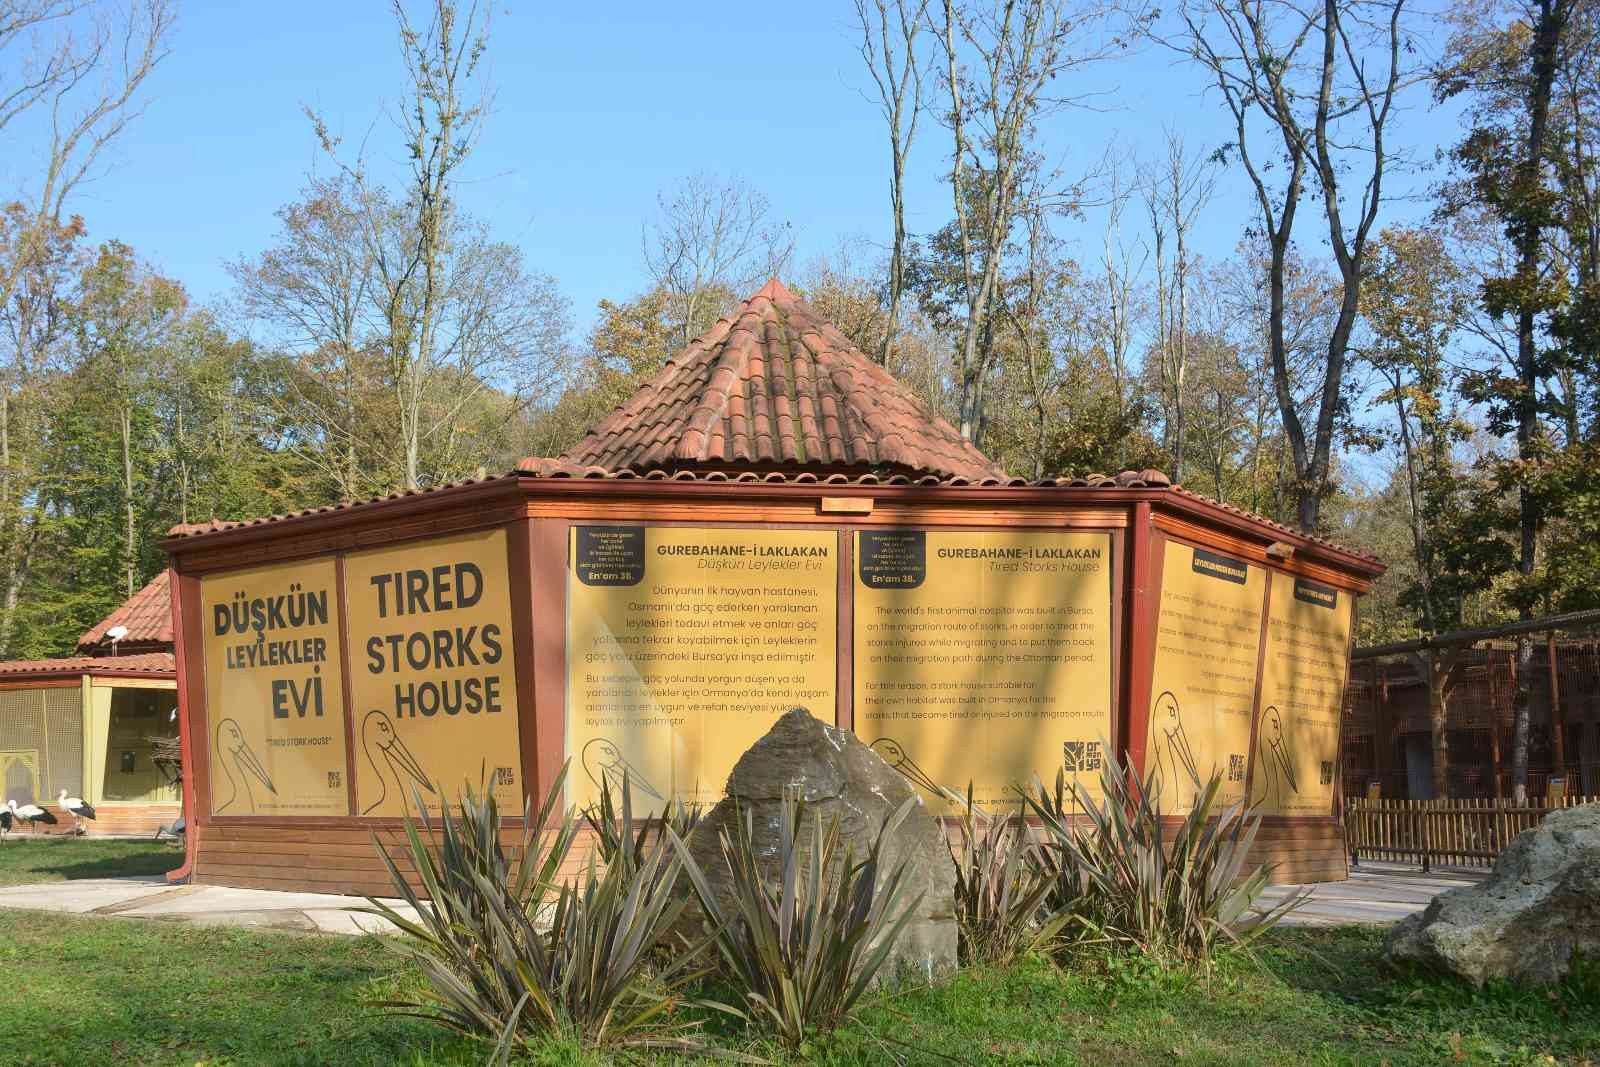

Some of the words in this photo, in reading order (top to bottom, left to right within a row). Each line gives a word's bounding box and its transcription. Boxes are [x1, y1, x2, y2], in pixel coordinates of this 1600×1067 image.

[657, 544, 757, 556] GUREBAHANE-İ
[760, 545, 828, 557] LAKLAKAN
[937, 547, 1032, 559] GUREBAHANE-İ
[1035, 548, 1101, 559] LAKLAKAN
[697, 558, 745, 572] Düşkün
[748, 559, 801, 573] Leylekler
[805, 560, 823, 570] Evi
[989, 562, 1019, 572] Tired
[1022, 562, 1058, 572] Storks
[1061, 562, 1100, 572] House
[370, 562, 483, 618] TIRED
[720, 586, 761, 597] hayvan
[213, 583, 329, 640] DÜŞKÜN
[692, 603, 713, 614] göç
[716, 602, 760, 612] ederken
[762, 602, 817, 614] yaralanan
[876, 607, 893, 615] The
[945, 607, 977, 615] animal
[712, 619, 745, 629] etmek
[797, 621, 817, 631] göç
[226, 638, 327, 669] LEYLEKLER
[366, 623, 502, 674] STORKS
[692, 651, 739, 663] Bursa'ya
[664, 674, 705, 685] yolunda
[707, 675, 742, 685] yorgun
[271, 667, 324, 719] EVİ
[394, 676, 502, 719] HOUSE
[770, 702, 801, 713] yükse
